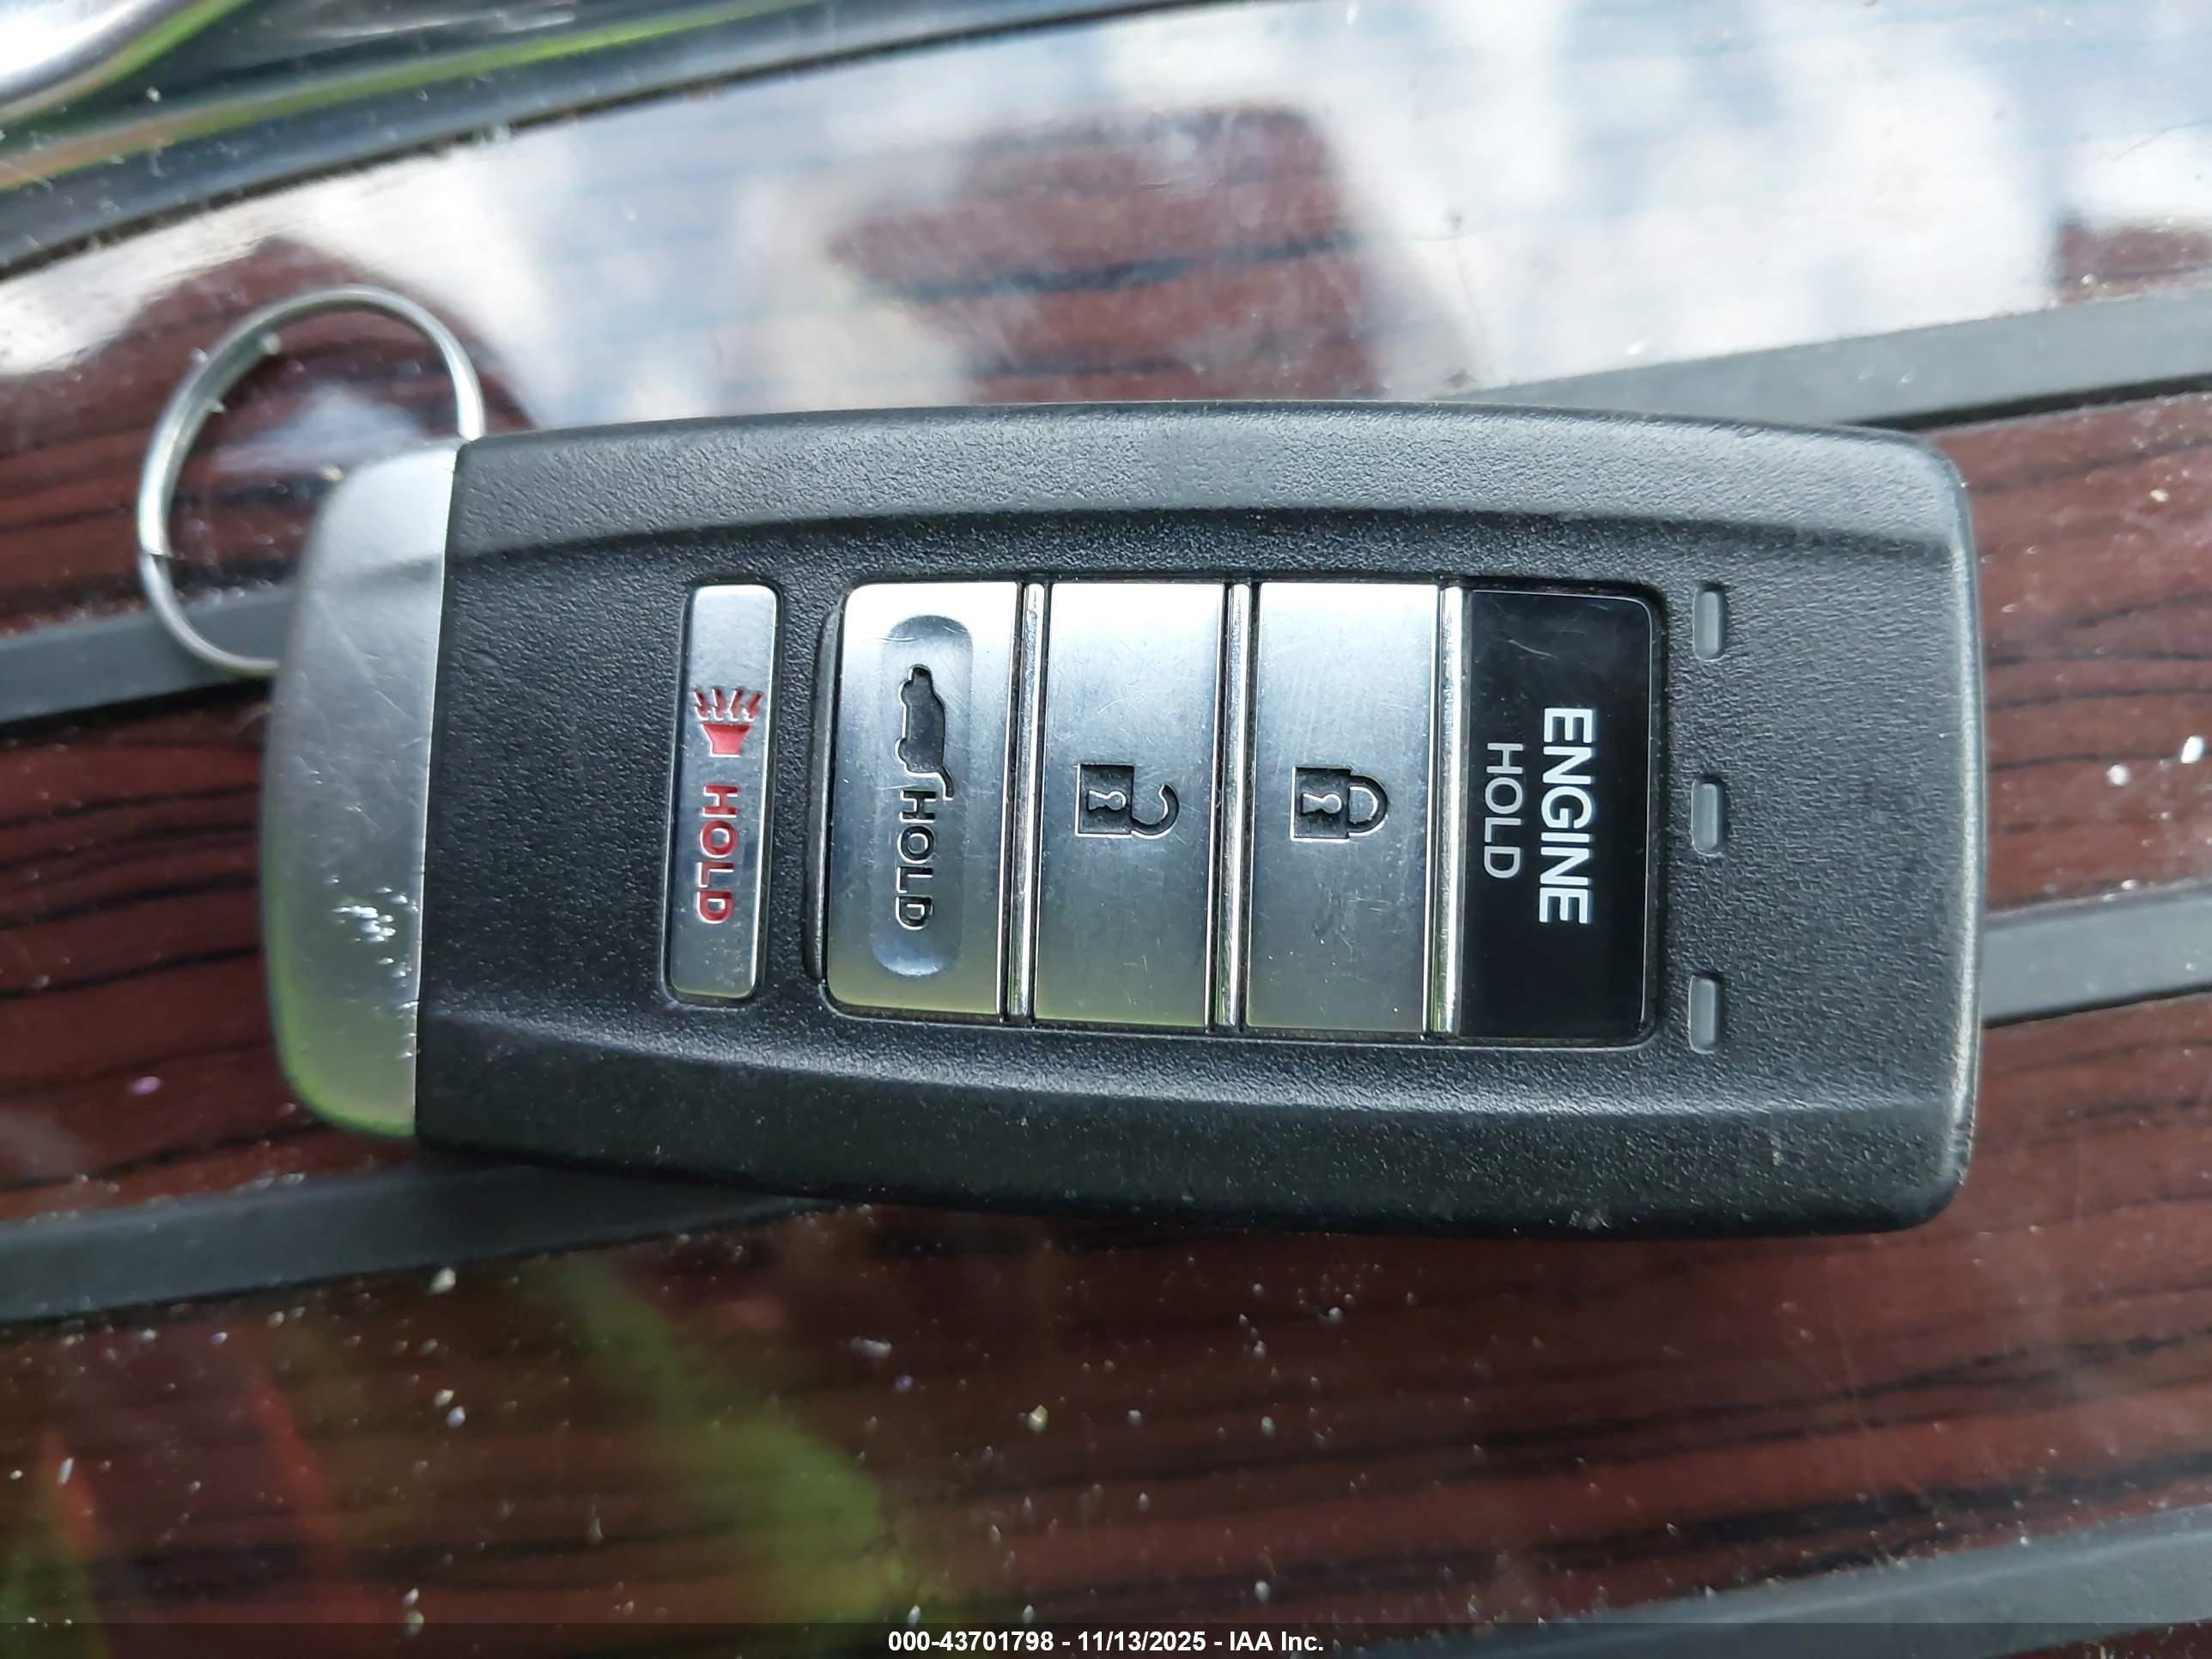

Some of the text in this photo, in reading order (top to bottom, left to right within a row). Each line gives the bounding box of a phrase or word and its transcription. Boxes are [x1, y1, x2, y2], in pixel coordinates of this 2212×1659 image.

[696, 783, 738, 925] HOLD
[895, 789, 936, 931] HOLD
[1484, 742, 1525, 879] HOLD
[1539, 708, 1594, 924] ENGINE
